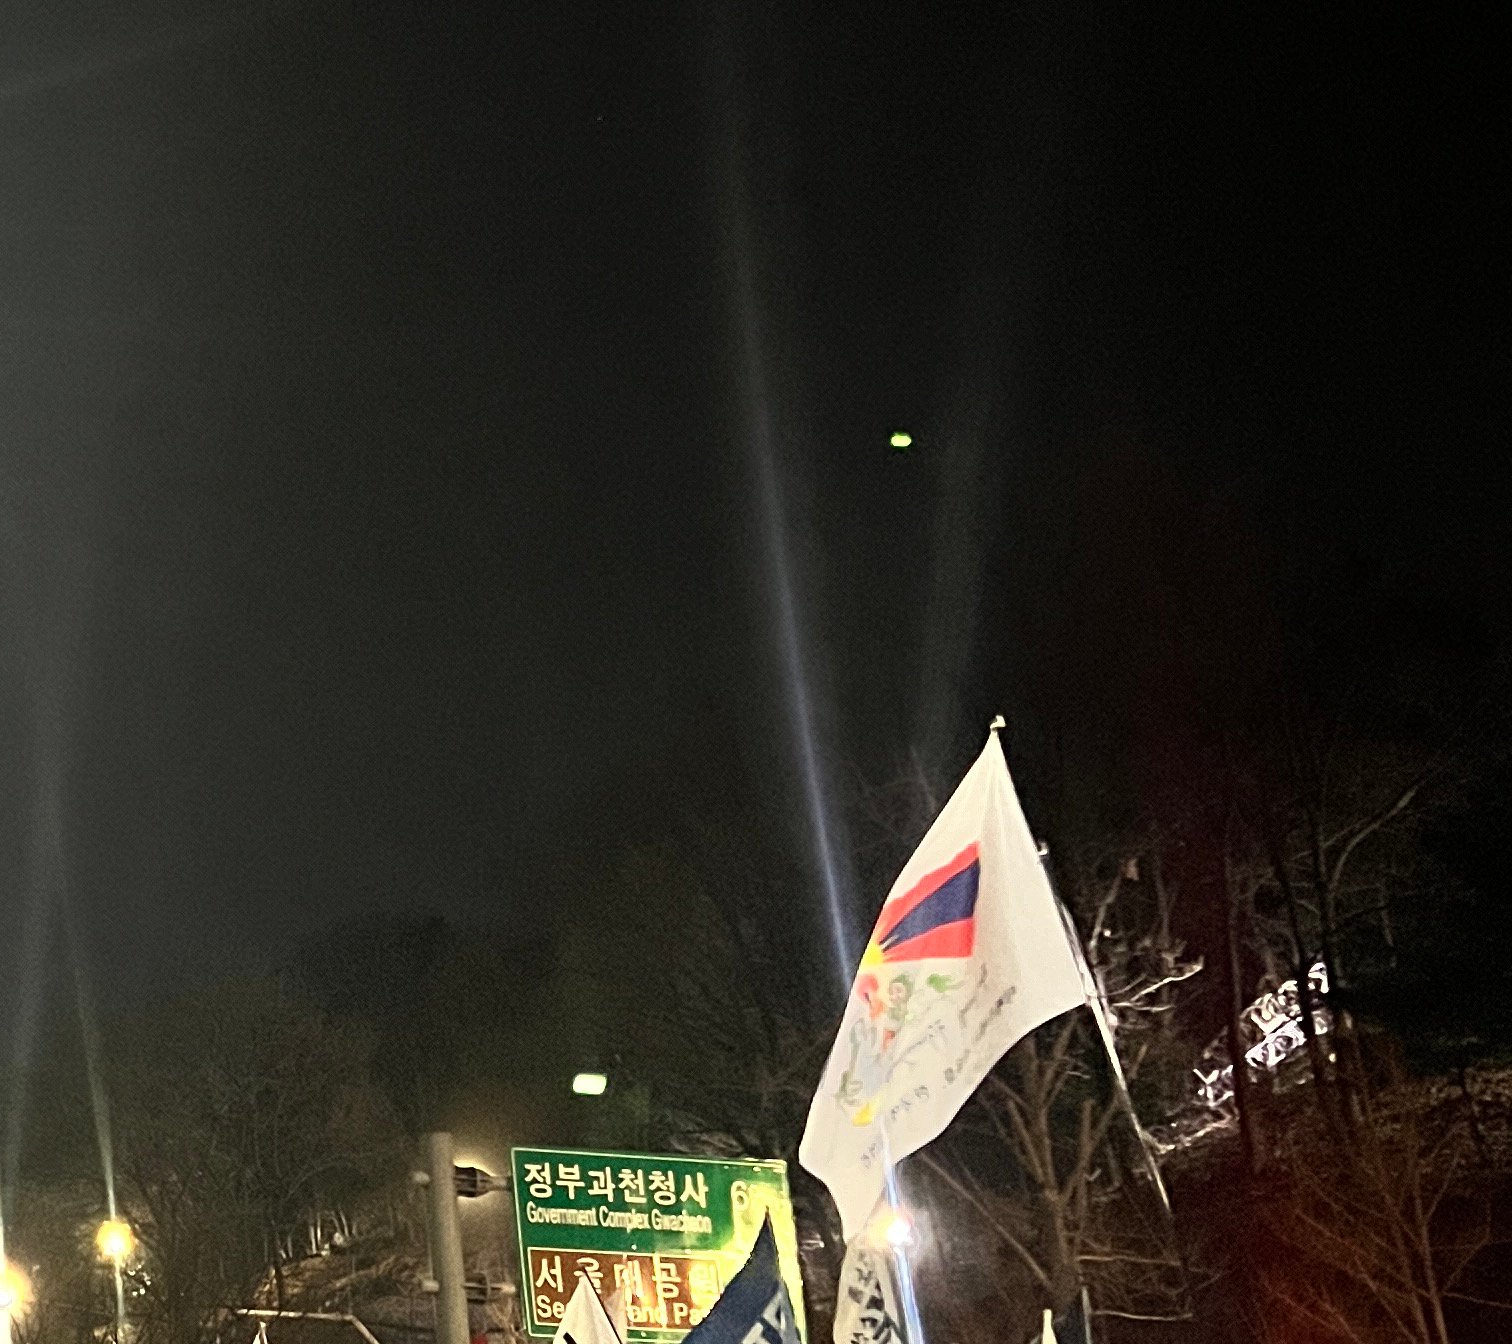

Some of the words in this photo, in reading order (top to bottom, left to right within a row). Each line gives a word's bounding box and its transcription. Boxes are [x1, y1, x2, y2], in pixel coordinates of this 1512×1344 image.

[523, 1161, 709, 1208] 정부과천청사
[526, 1200, 598, 1226] Government
[599, 1205, 650, 1233] Complex
